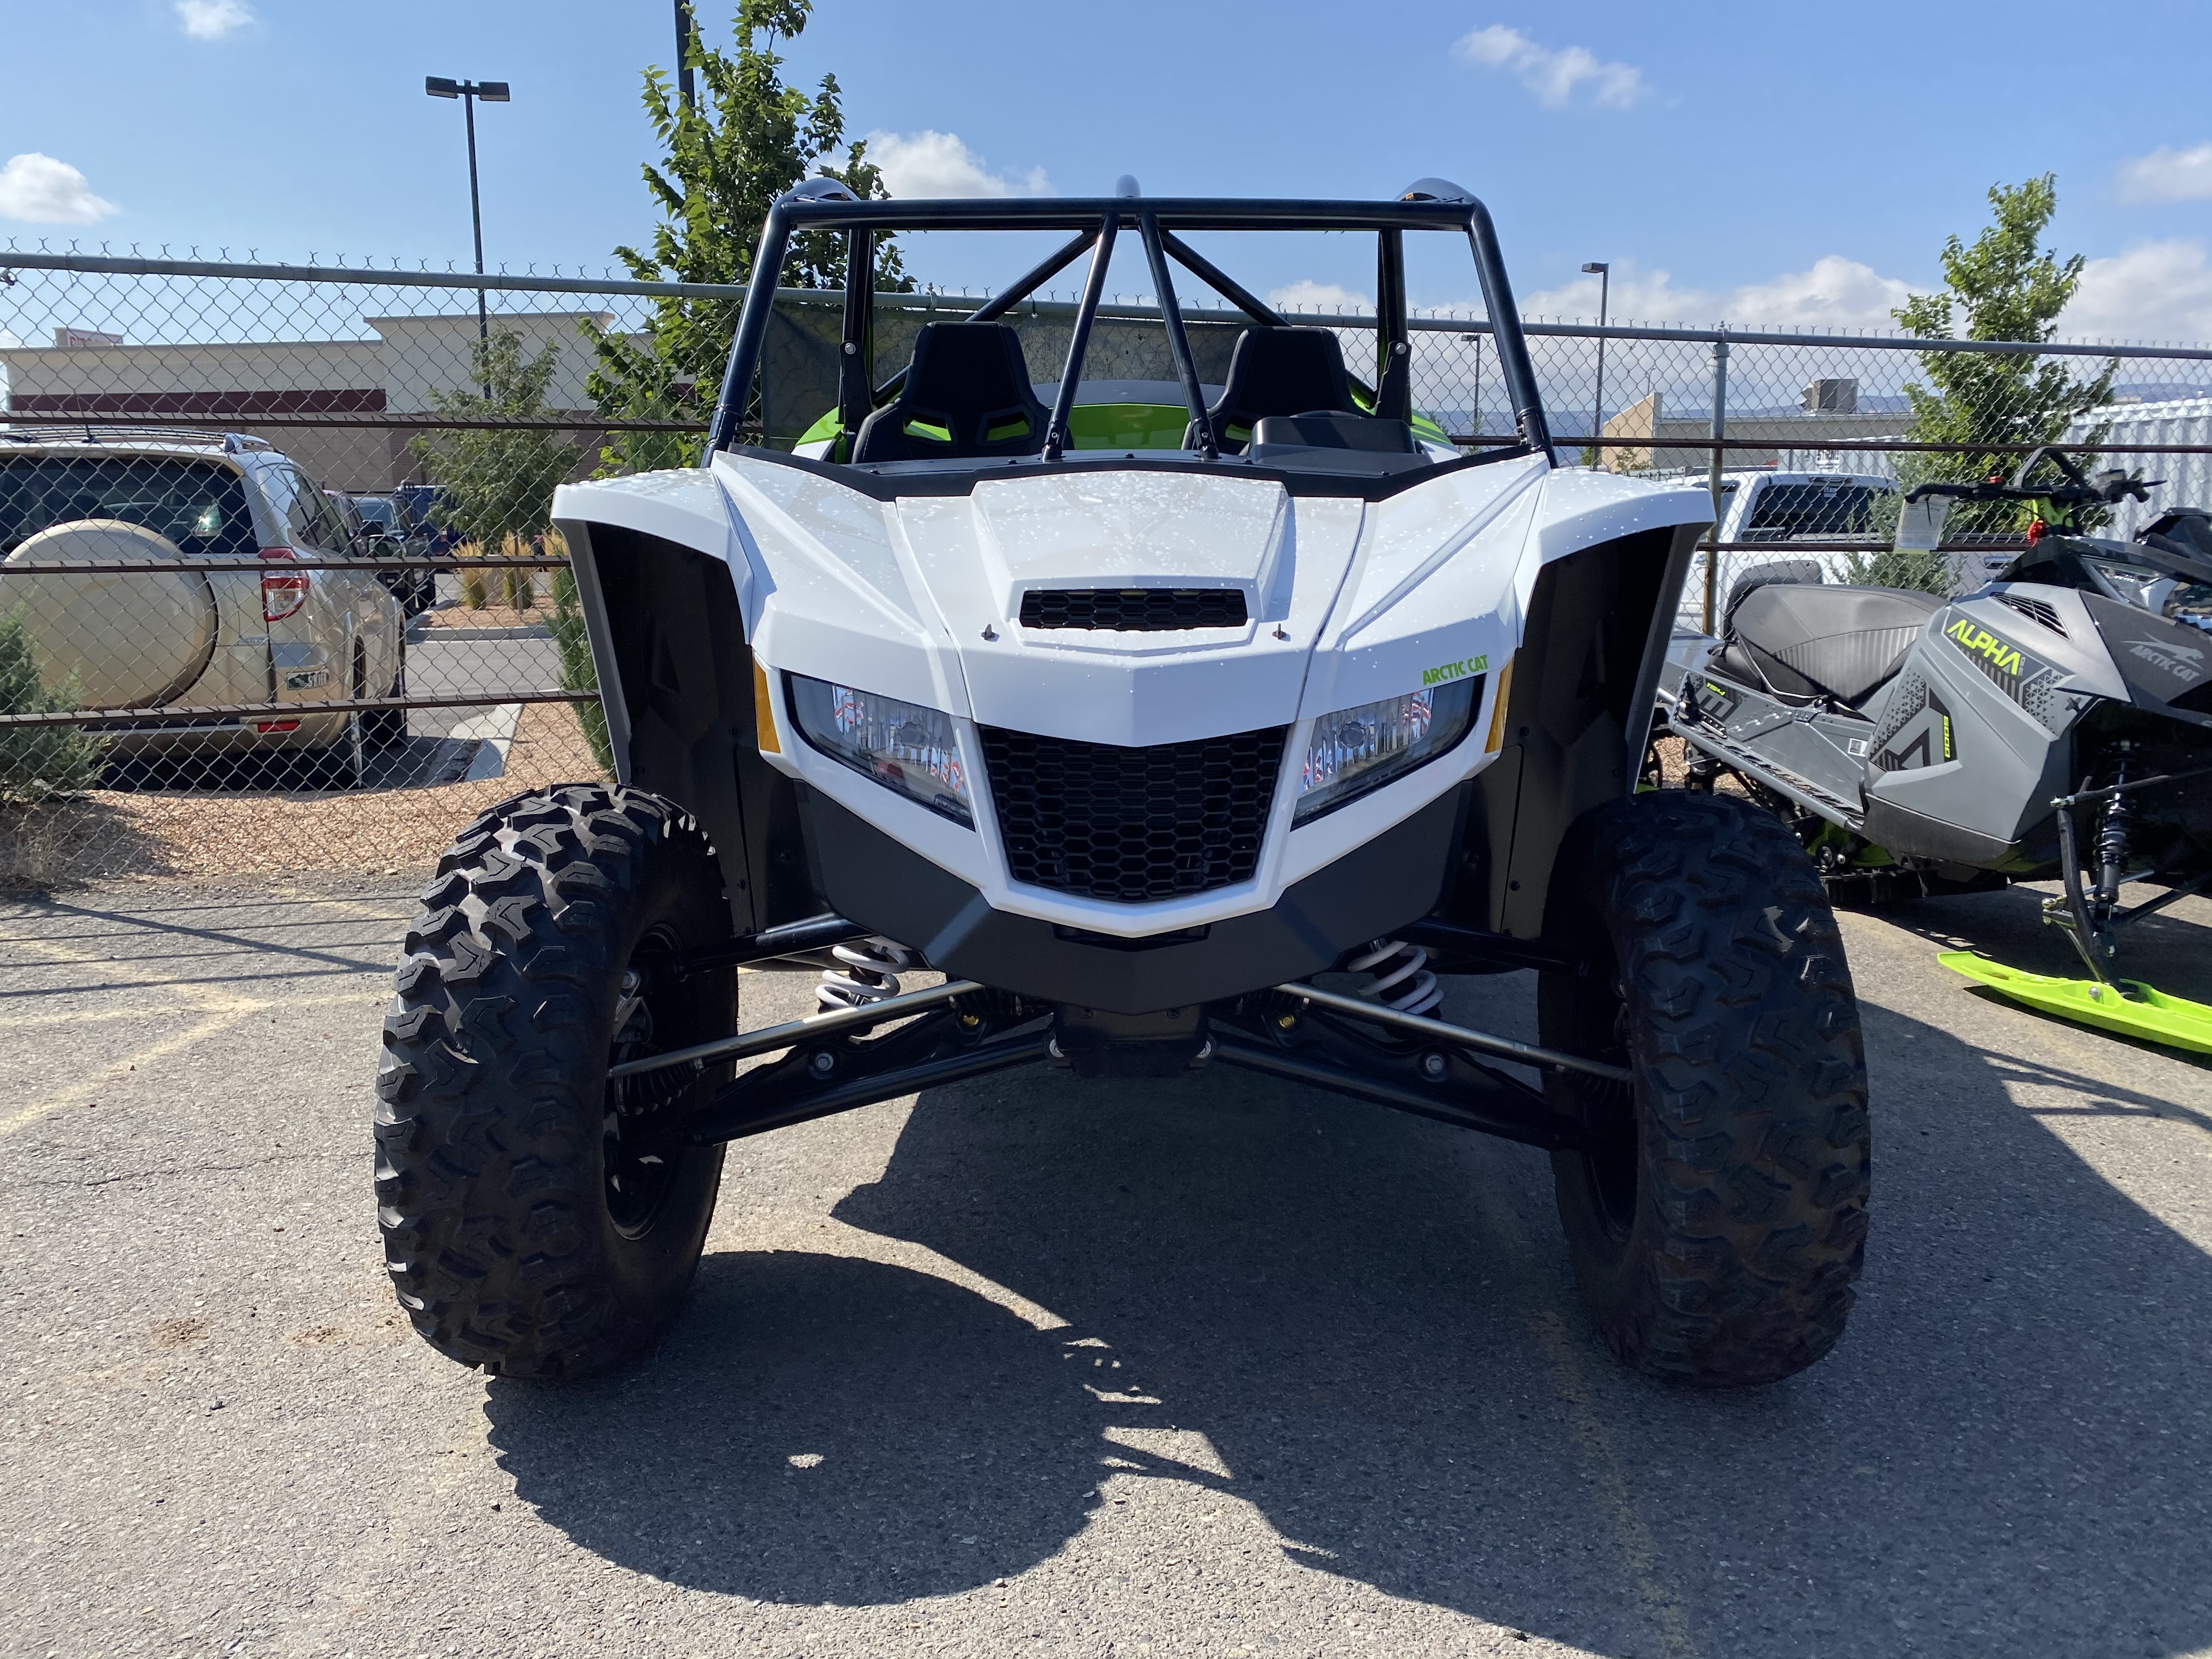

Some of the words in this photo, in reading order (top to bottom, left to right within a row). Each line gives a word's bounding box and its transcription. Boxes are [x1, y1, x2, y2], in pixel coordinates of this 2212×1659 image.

[1948, 619, 2021, 675] ALPHA
[2129, 645, 2177, 670] ARCTIC
[2172, 665, 2201, 682] CAT
[1423, 661, 1466, 685] ARCTIC
[1467, 654, 1488, 673] CAT
